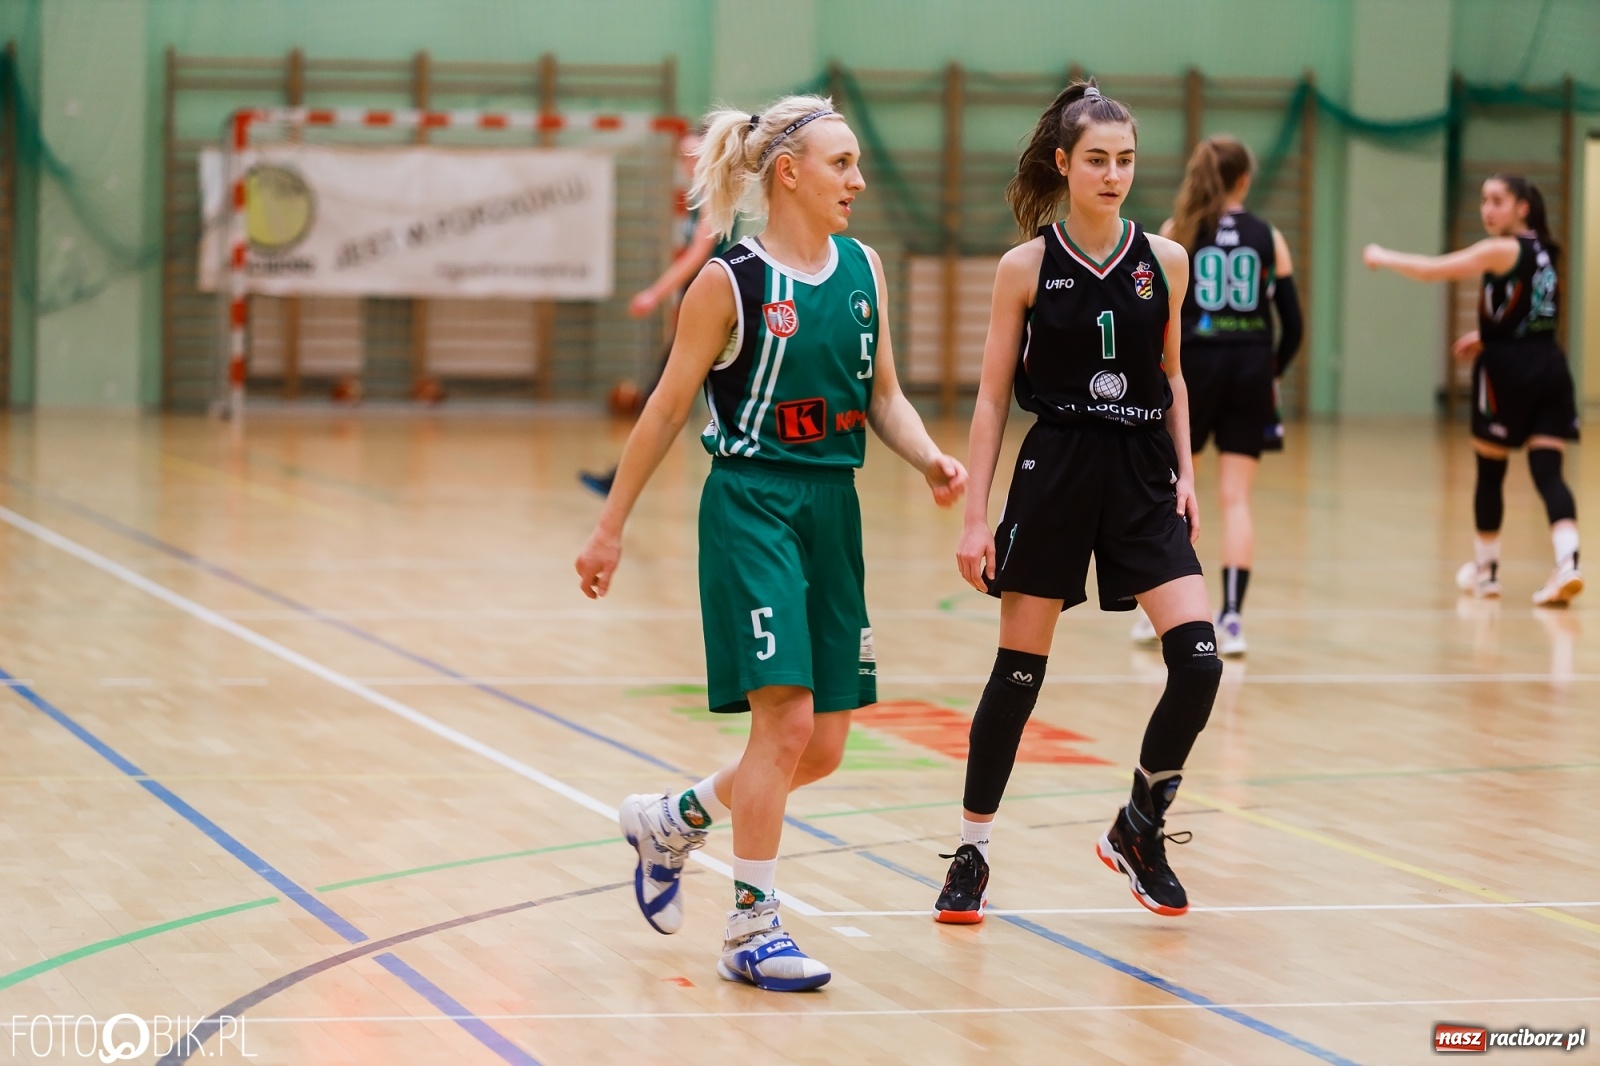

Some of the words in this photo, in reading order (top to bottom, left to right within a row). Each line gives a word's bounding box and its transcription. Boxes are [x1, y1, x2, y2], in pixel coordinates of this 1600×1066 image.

[1194, 246, 1262, 312] 99
[856, 333, 873, 380] 5
[1096, 310, 1116, 360] 1
[780, 403, 821, 438] K
[1087, 403, 1162, 421] LOGISTICS
[750, 606, 776, 661] 5
